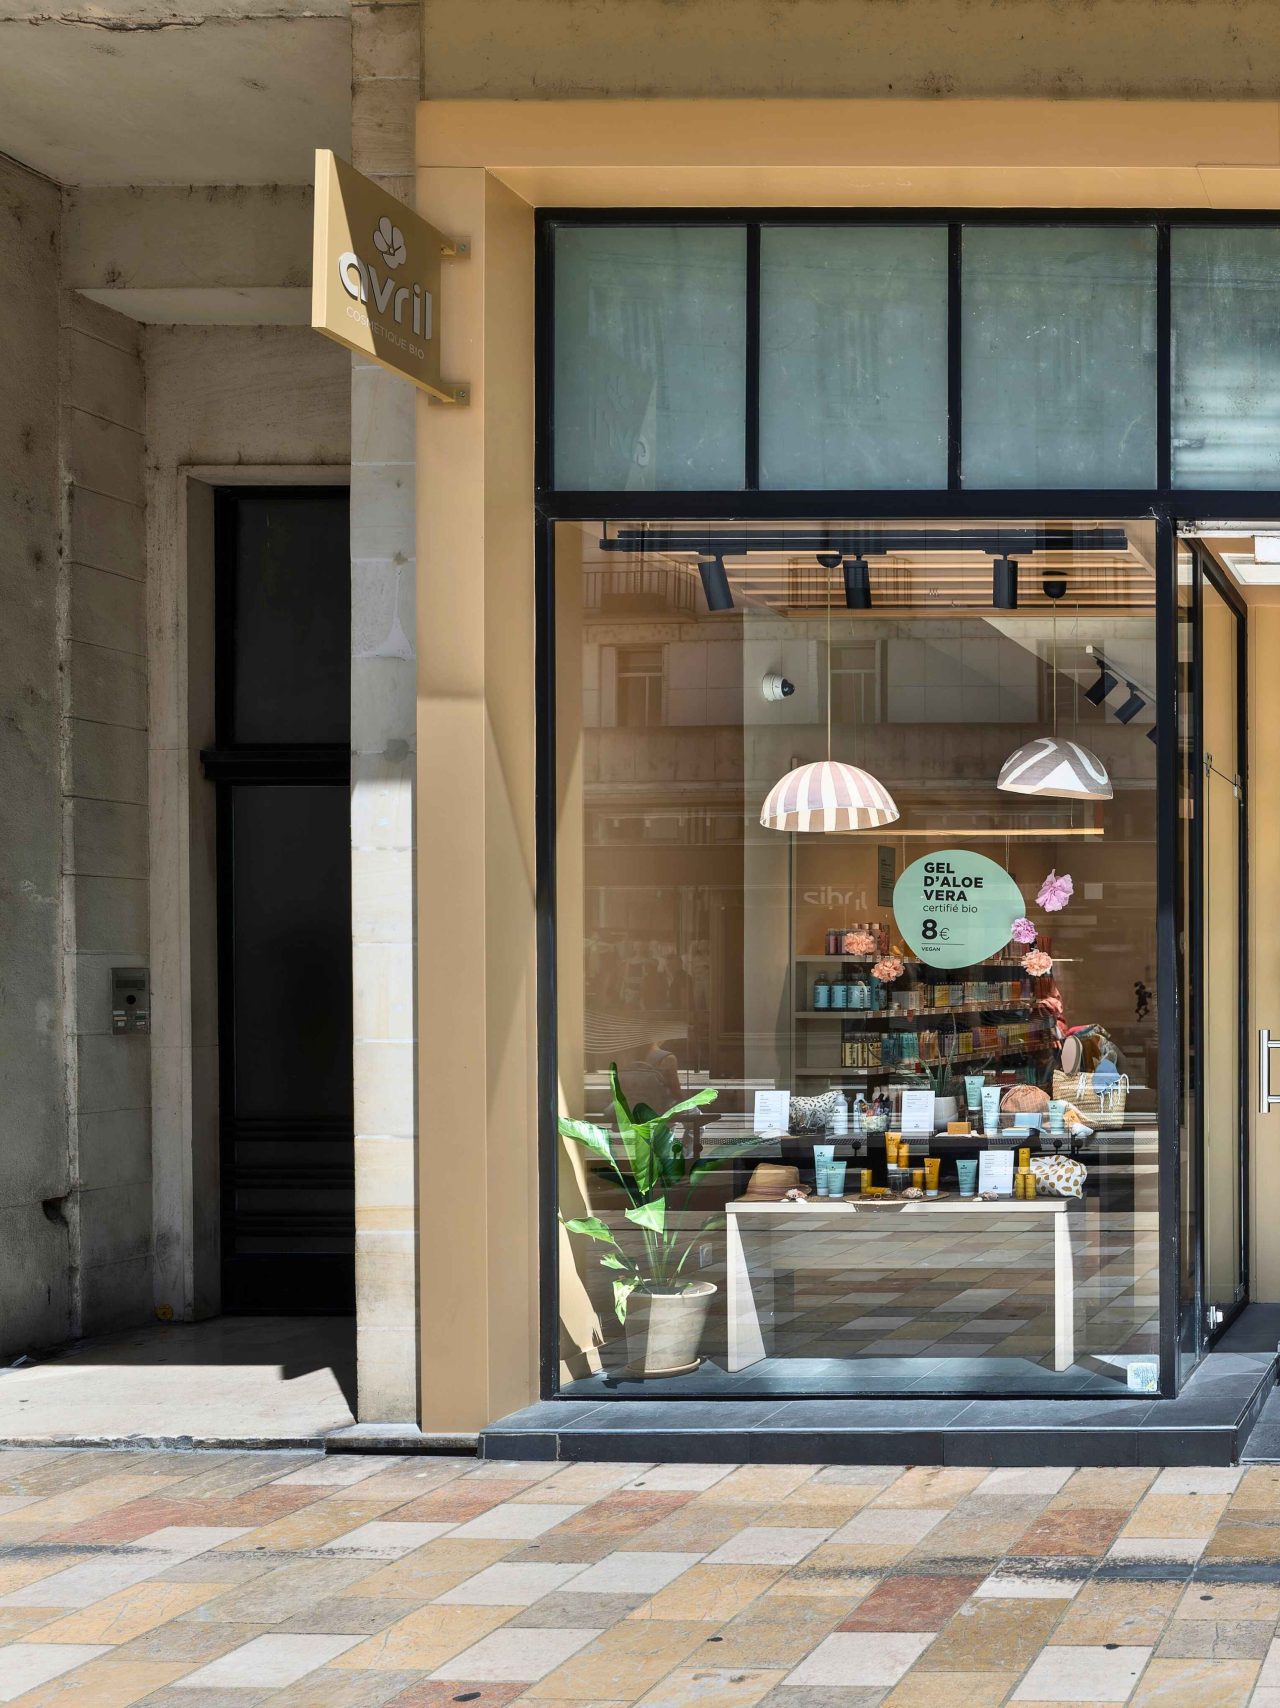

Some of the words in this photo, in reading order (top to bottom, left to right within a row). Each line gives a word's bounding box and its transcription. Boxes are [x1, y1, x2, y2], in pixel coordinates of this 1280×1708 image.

[339, 252, 433, 340] avril
[409, 343, 425, 360] BIO
[924, 862, 955, 873] GEL
[923, 890, 968, 902] VERA
[922, 904, 958, 912] certifié
[962, 904, 978, 914] bio
